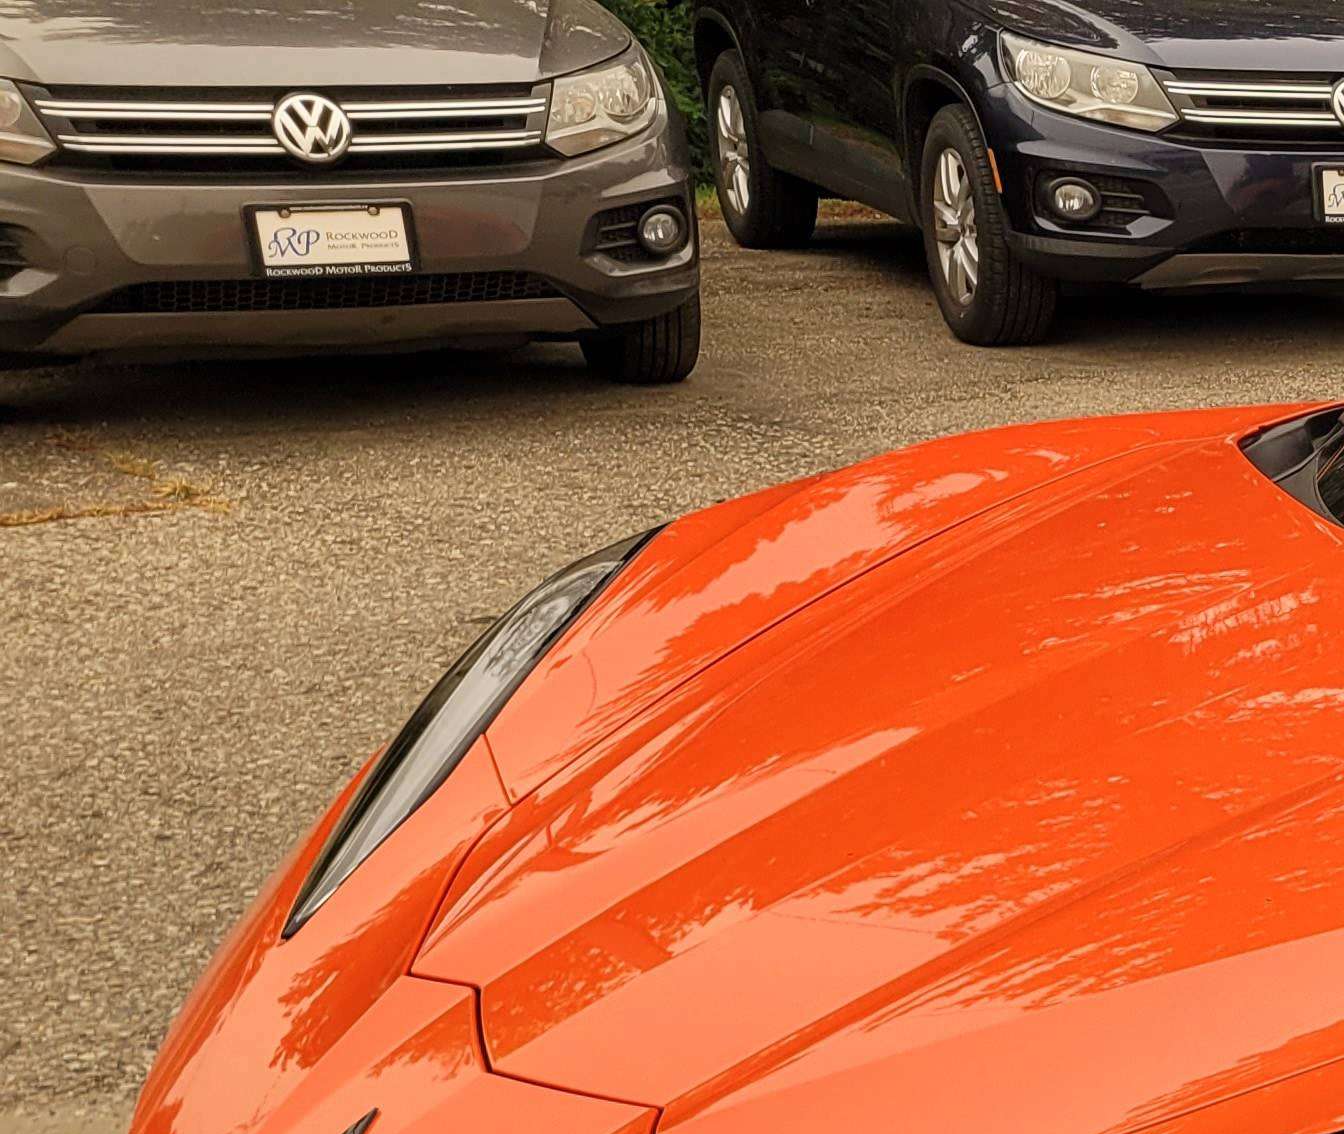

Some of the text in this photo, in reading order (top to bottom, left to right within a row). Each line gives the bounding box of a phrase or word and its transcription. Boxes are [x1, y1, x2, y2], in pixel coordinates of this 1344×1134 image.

[325, 230, 399, 241] ROCKWOOD
[266, 262, 412, 277] ROCKWOOD MOTOR PRODUCTS
